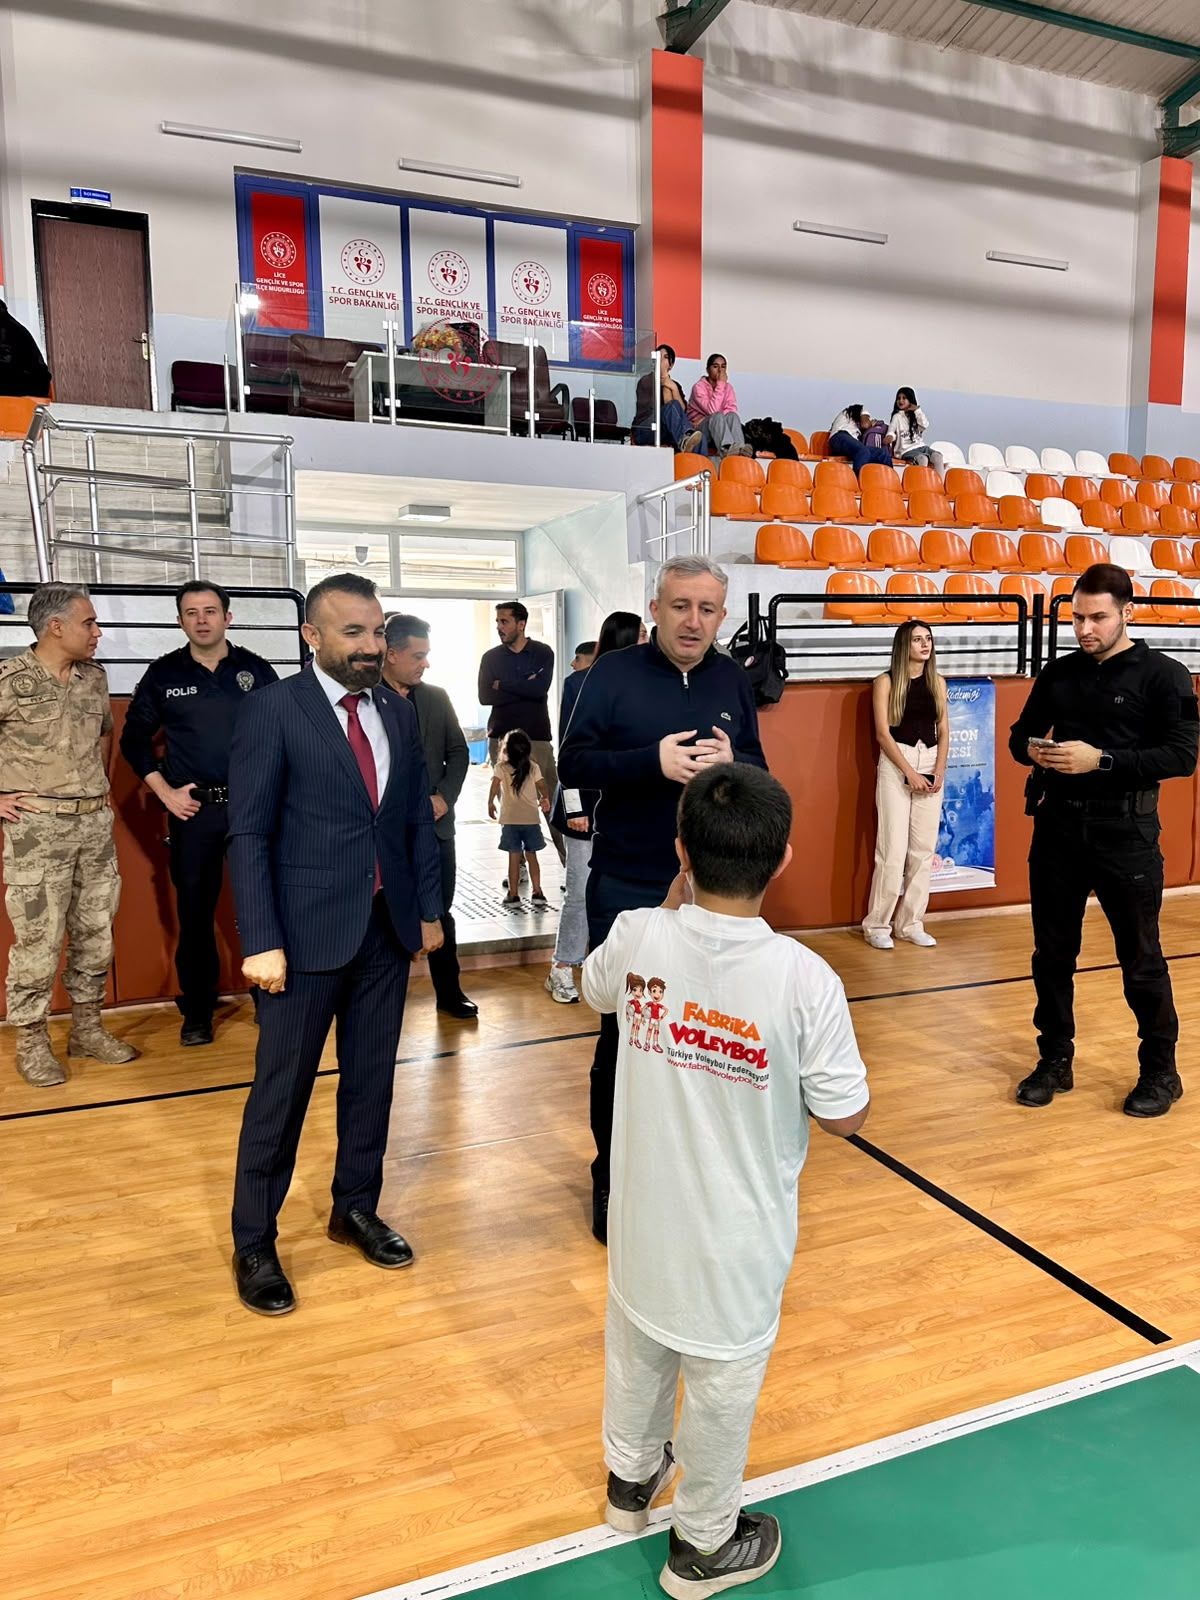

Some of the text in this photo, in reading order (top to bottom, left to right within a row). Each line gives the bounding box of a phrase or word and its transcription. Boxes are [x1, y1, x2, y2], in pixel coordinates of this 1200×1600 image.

[331, 286, 397, 300] T.C. GENÇLİK VE
[329, 296, 400, 311] SPOR BAKANLIĞI
[418, 296, 480, 310] T.C. GENÇLİK VE
[416, 306, 484, 320] SPOR BAKANLIĞI
[502, 306, 561, 319] T.C. GENÇLİK VE
[500, 315, 564, 329] SPOR BAKANLIĞI
[668, 1022, 769, 1070] VOLEYBOL
[667, 1047, 694, 1062] Türkiye
[695, 1052, 726, 1070] Voleybol
